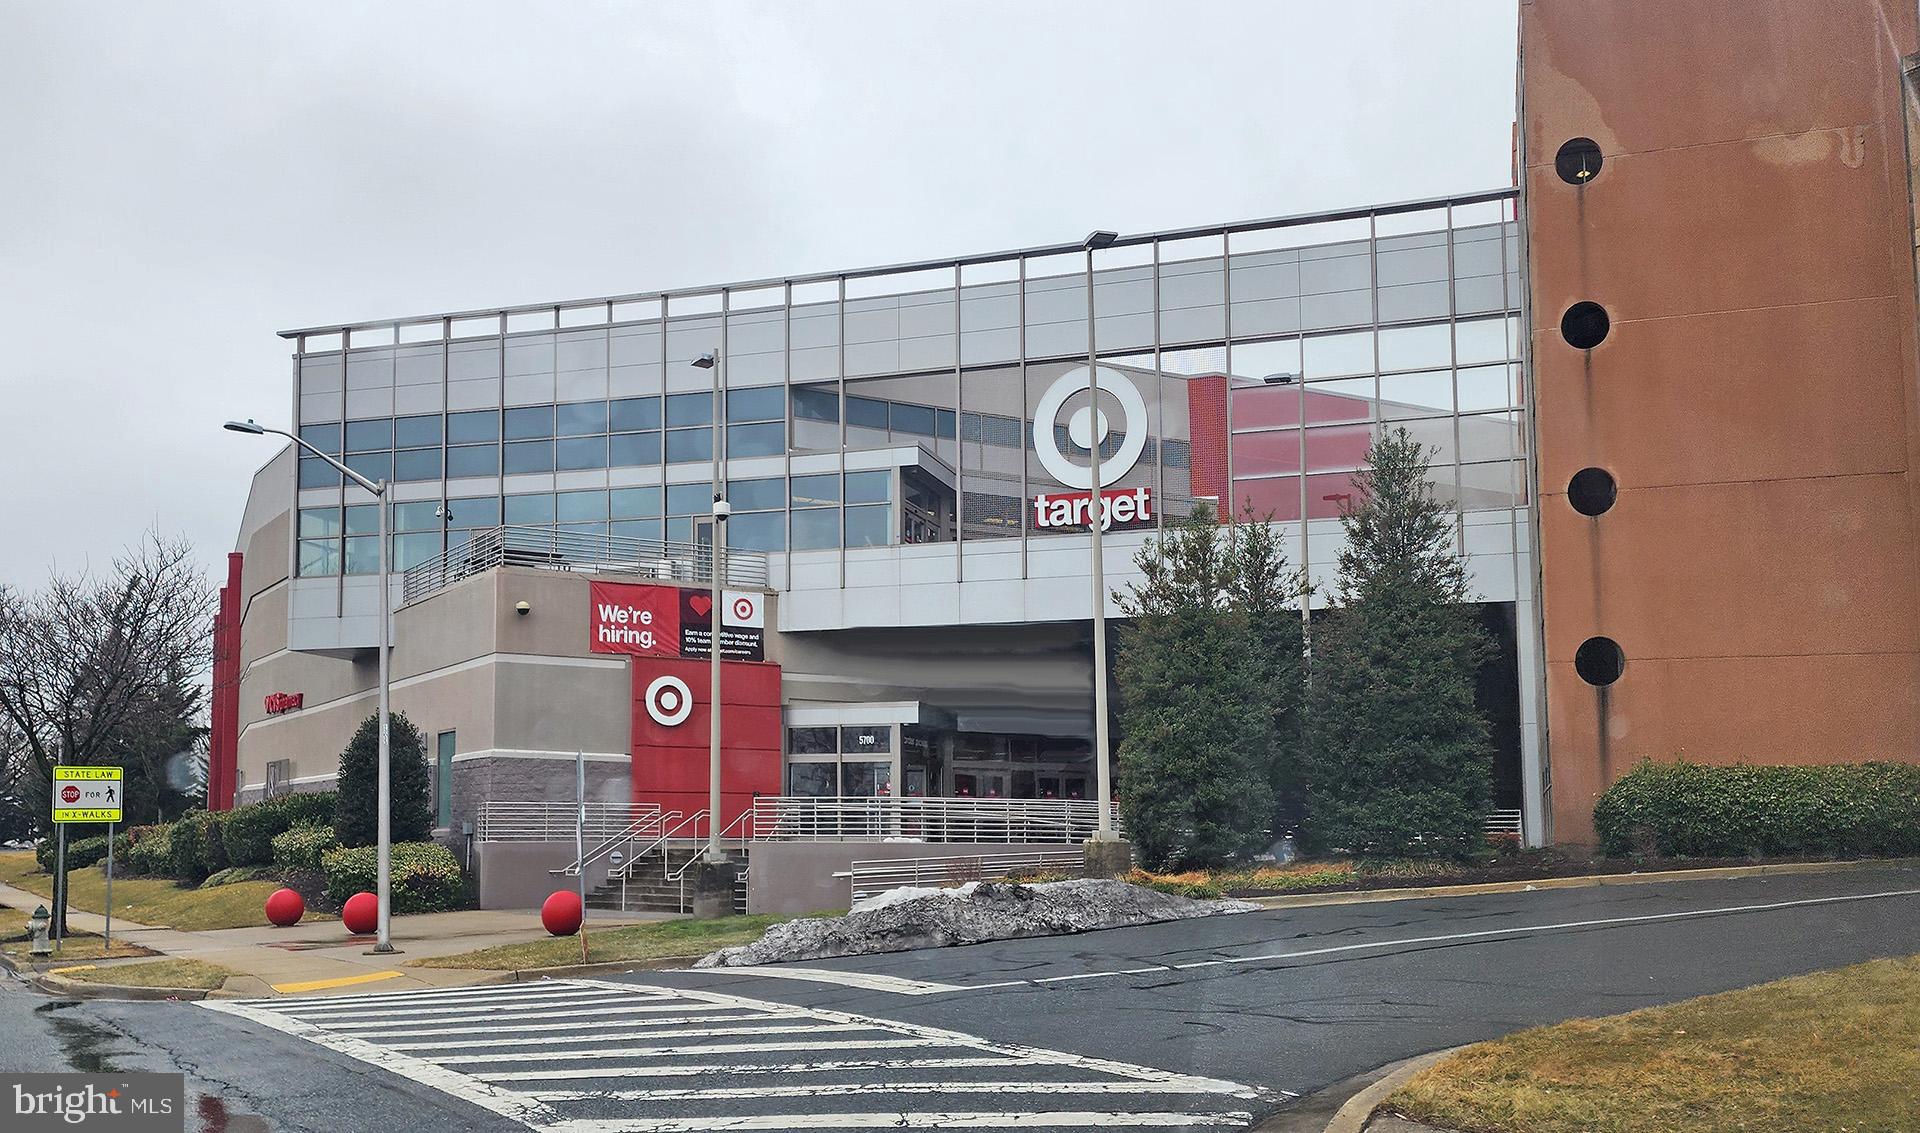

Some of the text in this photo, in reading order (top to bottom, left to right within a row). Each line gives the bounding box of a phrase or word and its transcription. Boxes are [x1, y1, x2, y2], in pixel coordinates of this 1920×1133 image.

[1034, 487, 1150, 532] target
[598, 603, 652, 625] We're
[598, 623, 657, 649] hiring.
[859, 735, 875, 745] 5700
[64, 770, 114, 779] STATE LAW
[62, 790, 101, 799] STOP FOR
[72, 811, 112, 819] X-WALKS
